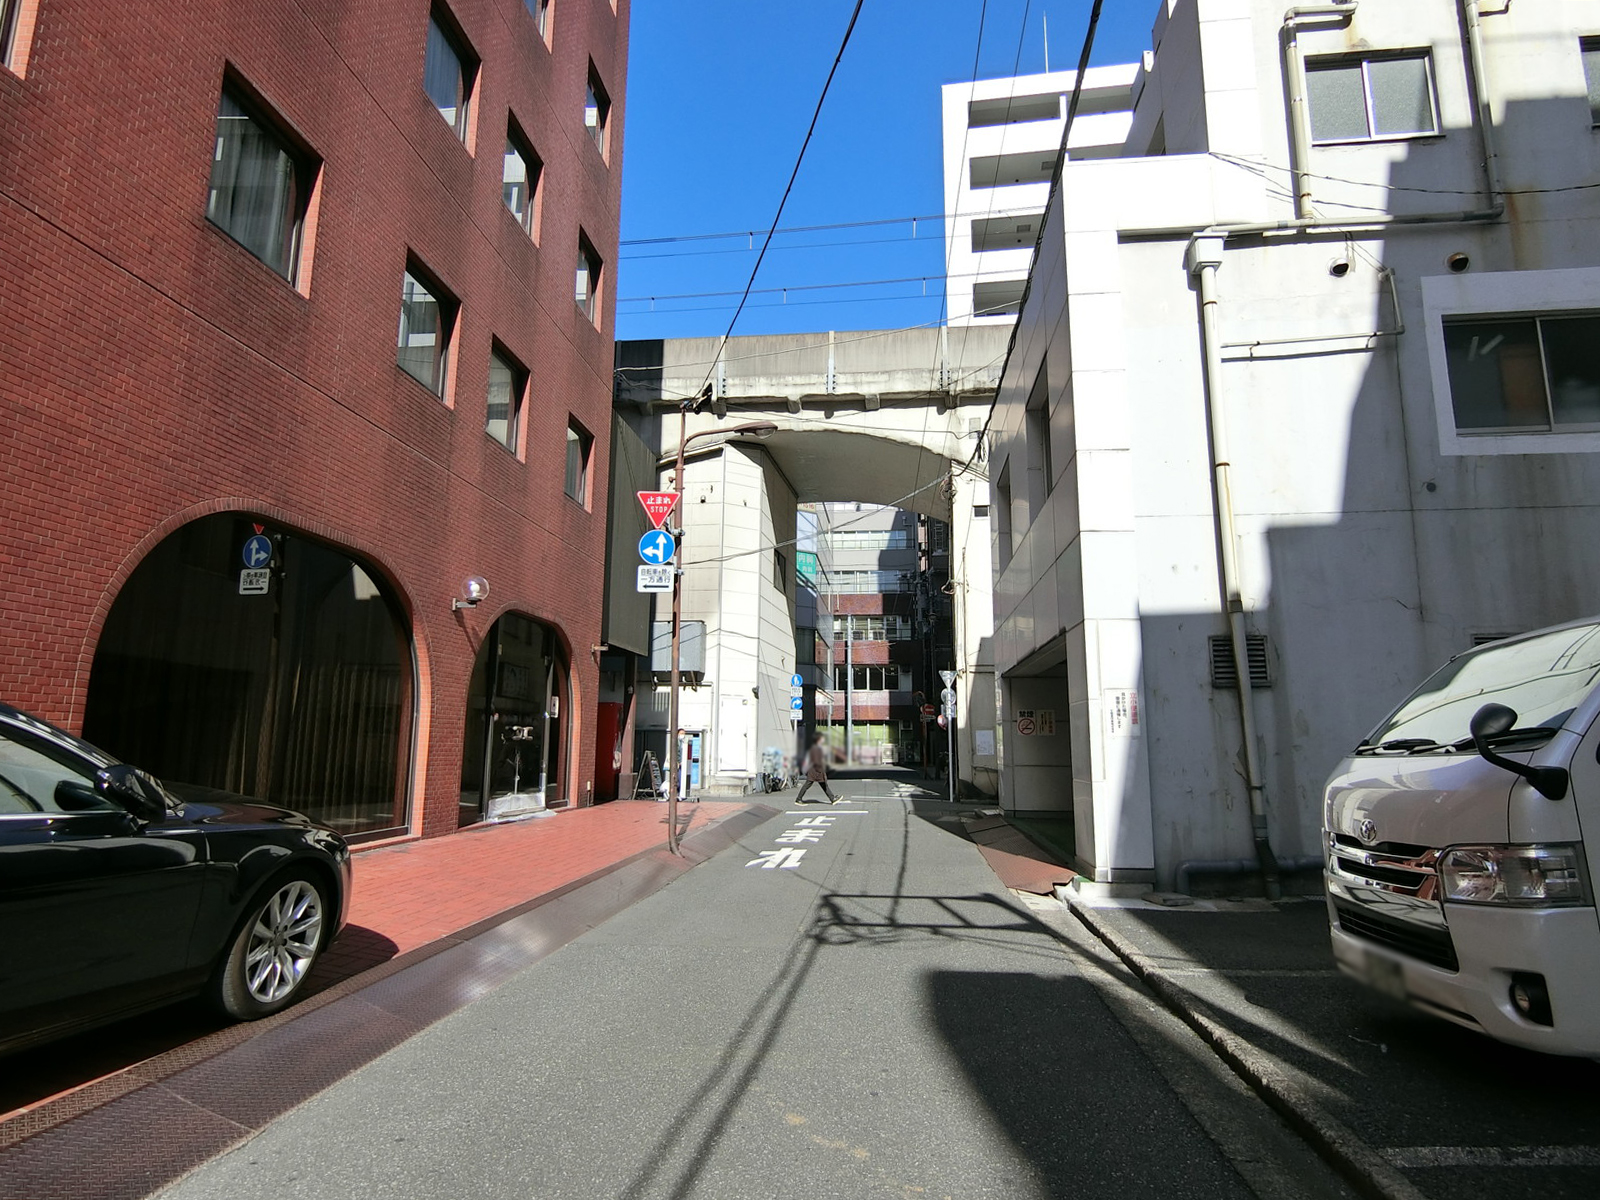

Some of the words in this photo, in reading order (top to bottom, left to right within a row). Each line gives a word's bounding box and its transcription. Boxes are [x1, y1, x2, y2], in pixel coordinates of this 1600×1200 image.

[646, 496, 671, 504] 止まれ
[640, 568, 671, 576] 自転車を除く
[640, 576, 671, 584] 一方通行
[1019, 710, 1034, 718] 禁煙
[745, 815, 836, 869] 止まれ
